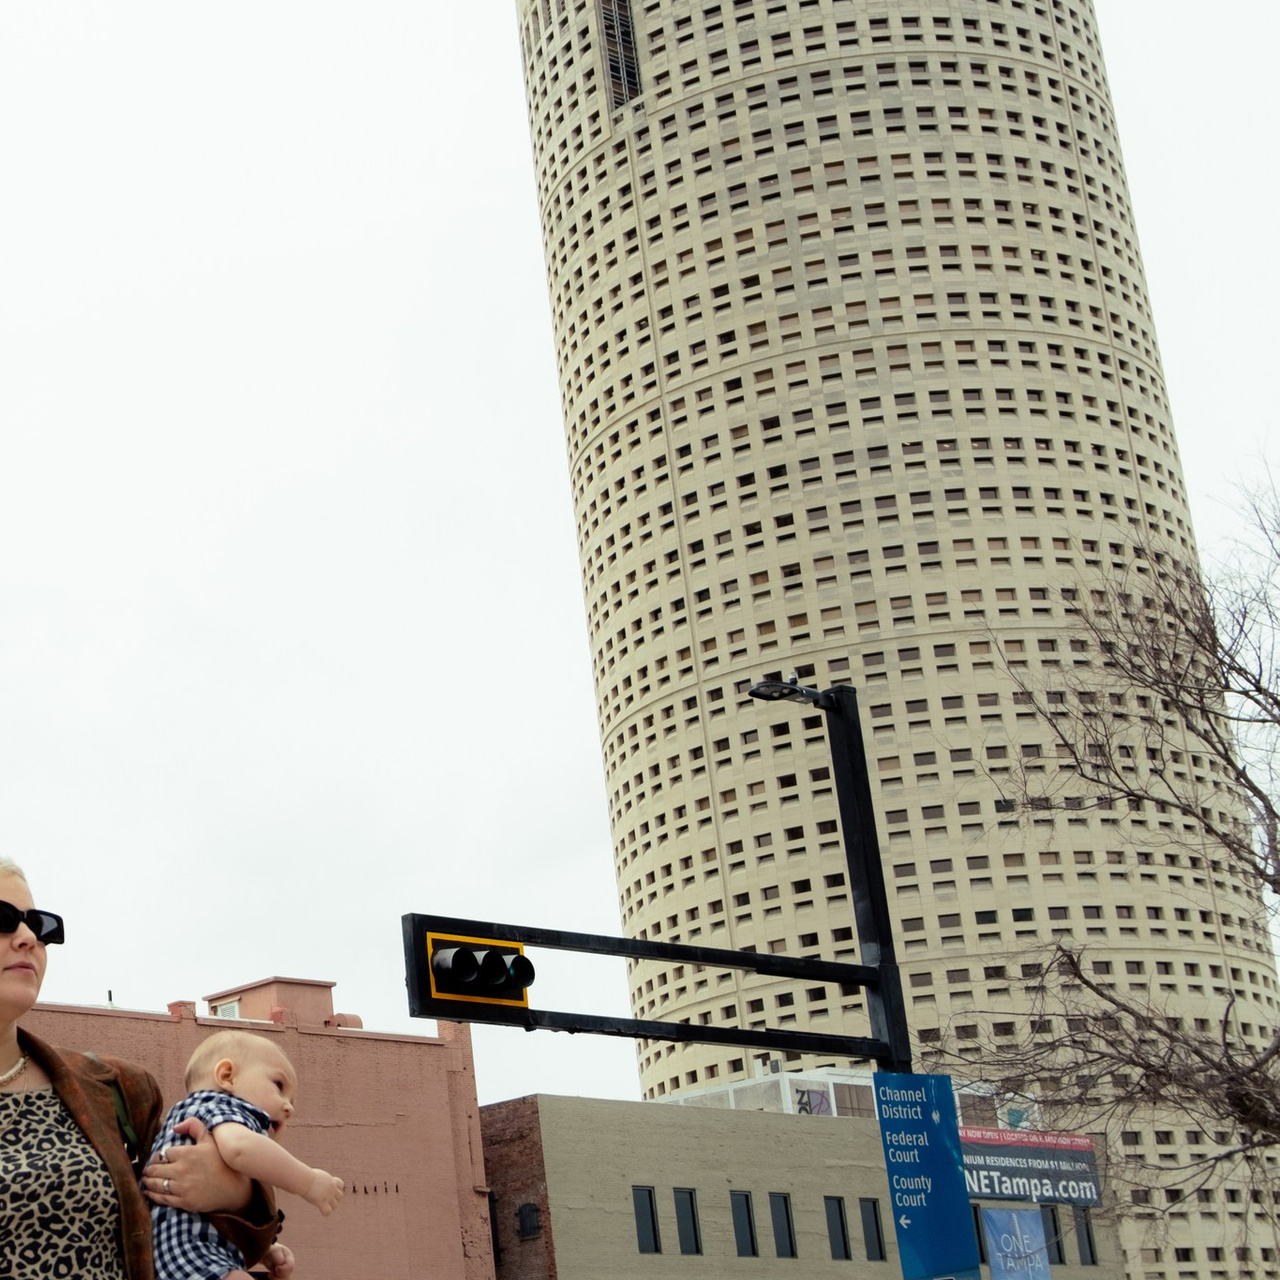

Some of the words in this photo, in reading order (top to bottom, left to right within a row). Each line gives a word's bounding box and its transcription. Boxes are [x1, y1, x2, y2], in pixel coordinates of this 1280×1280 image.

[879, 1086, 927, 1102] Channel
[881, 1104, 923, 1120] District
[885, 1131, 929, 1146] Federal
[888, 1148, 920, 1163] Court
[985, 1156, 1027, 1168] RESIDENCES
[1028, 1158, 1049, 1169] FROM
[892, 1174, 932, 1193] County
[963, 1169, 1098, 1202] NETampa.com
[895, 1192, 927, 1207] Court
[1000, 1233, 1033, 1253] ONE
